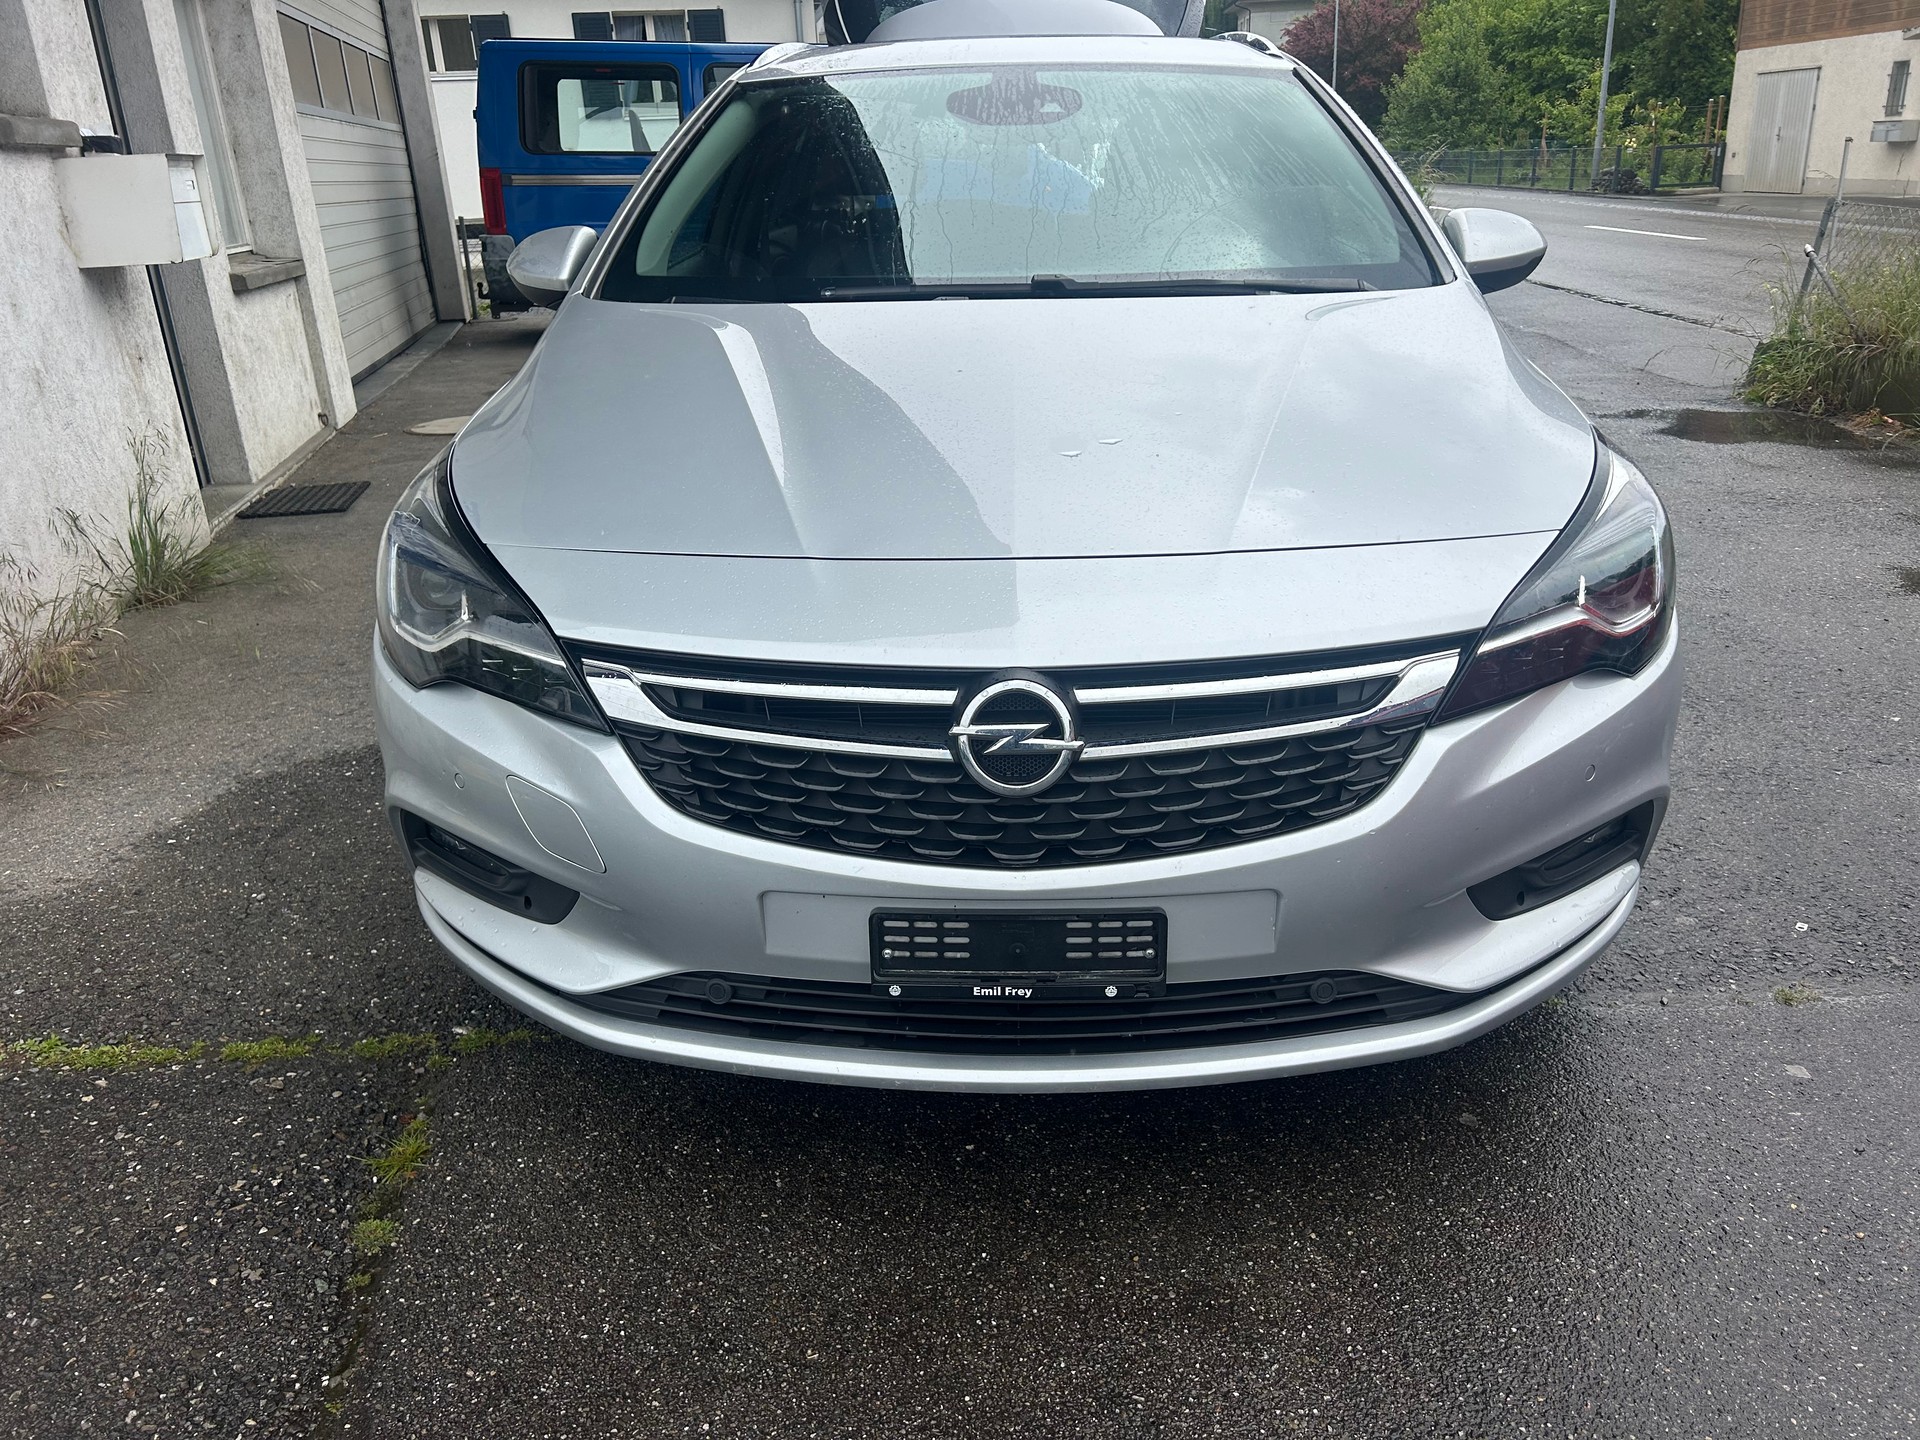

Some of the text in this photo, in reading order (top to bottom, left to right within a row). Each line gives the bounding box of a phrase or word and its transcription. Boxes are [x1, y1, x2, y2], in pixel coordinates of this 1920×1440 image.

[980, 681, 1052, 698] OPEL
[973, 986, 1033, 999] Emil Frey
